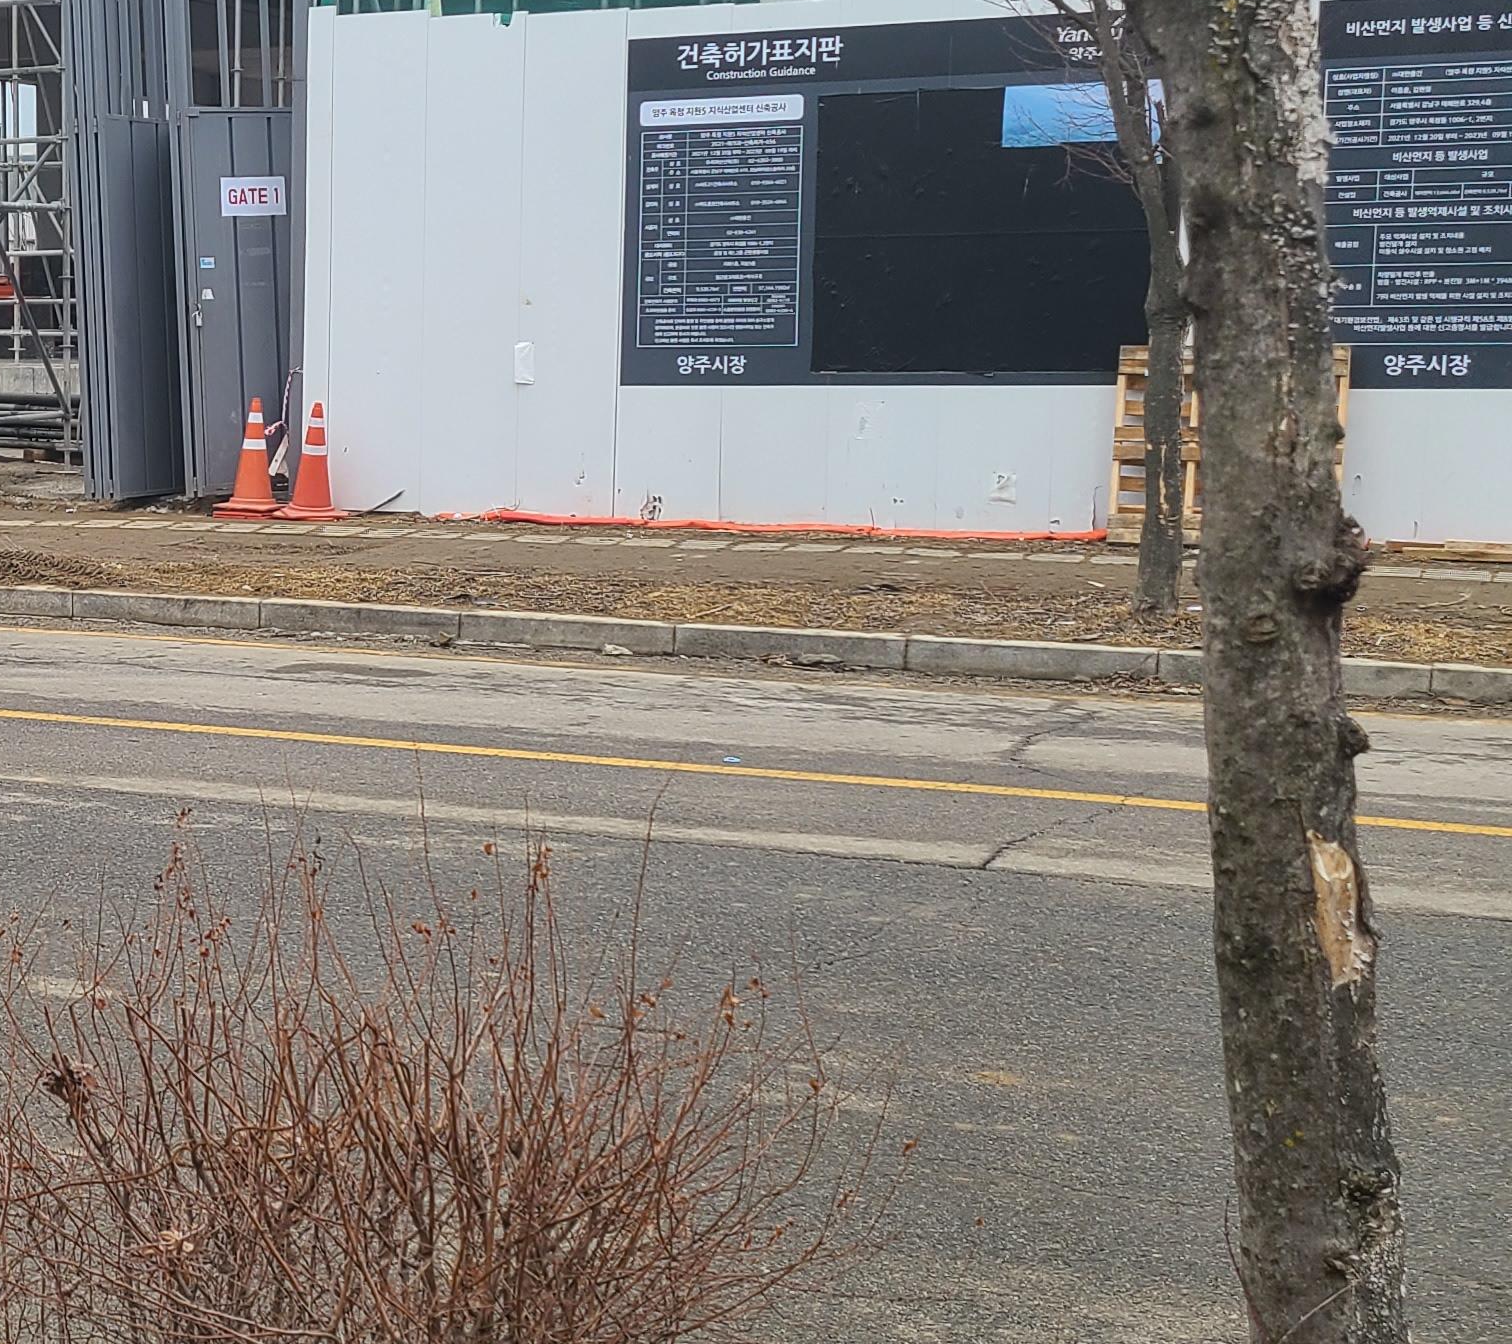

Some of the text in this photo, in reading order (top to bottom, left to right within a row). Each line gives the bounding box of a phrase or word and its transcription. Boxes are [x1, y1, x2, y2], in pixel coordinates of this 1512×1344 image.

[1346, 18, 1406, 37] 비산먼지
[1411, 15, 1472, 34] 발생사업
[1476, 14, 1494, 31] 등
[676, 35, 845, 69] 건축허가표지판
[1069, 46, 1103, 61] 양주
[706, 65, 816, 81] Construction Guidance
[228, 188, 279, 204] GATE 1
[676, 355, 747, 375] 양주시장
[1384, 354, 1472, 376] 양주시장
